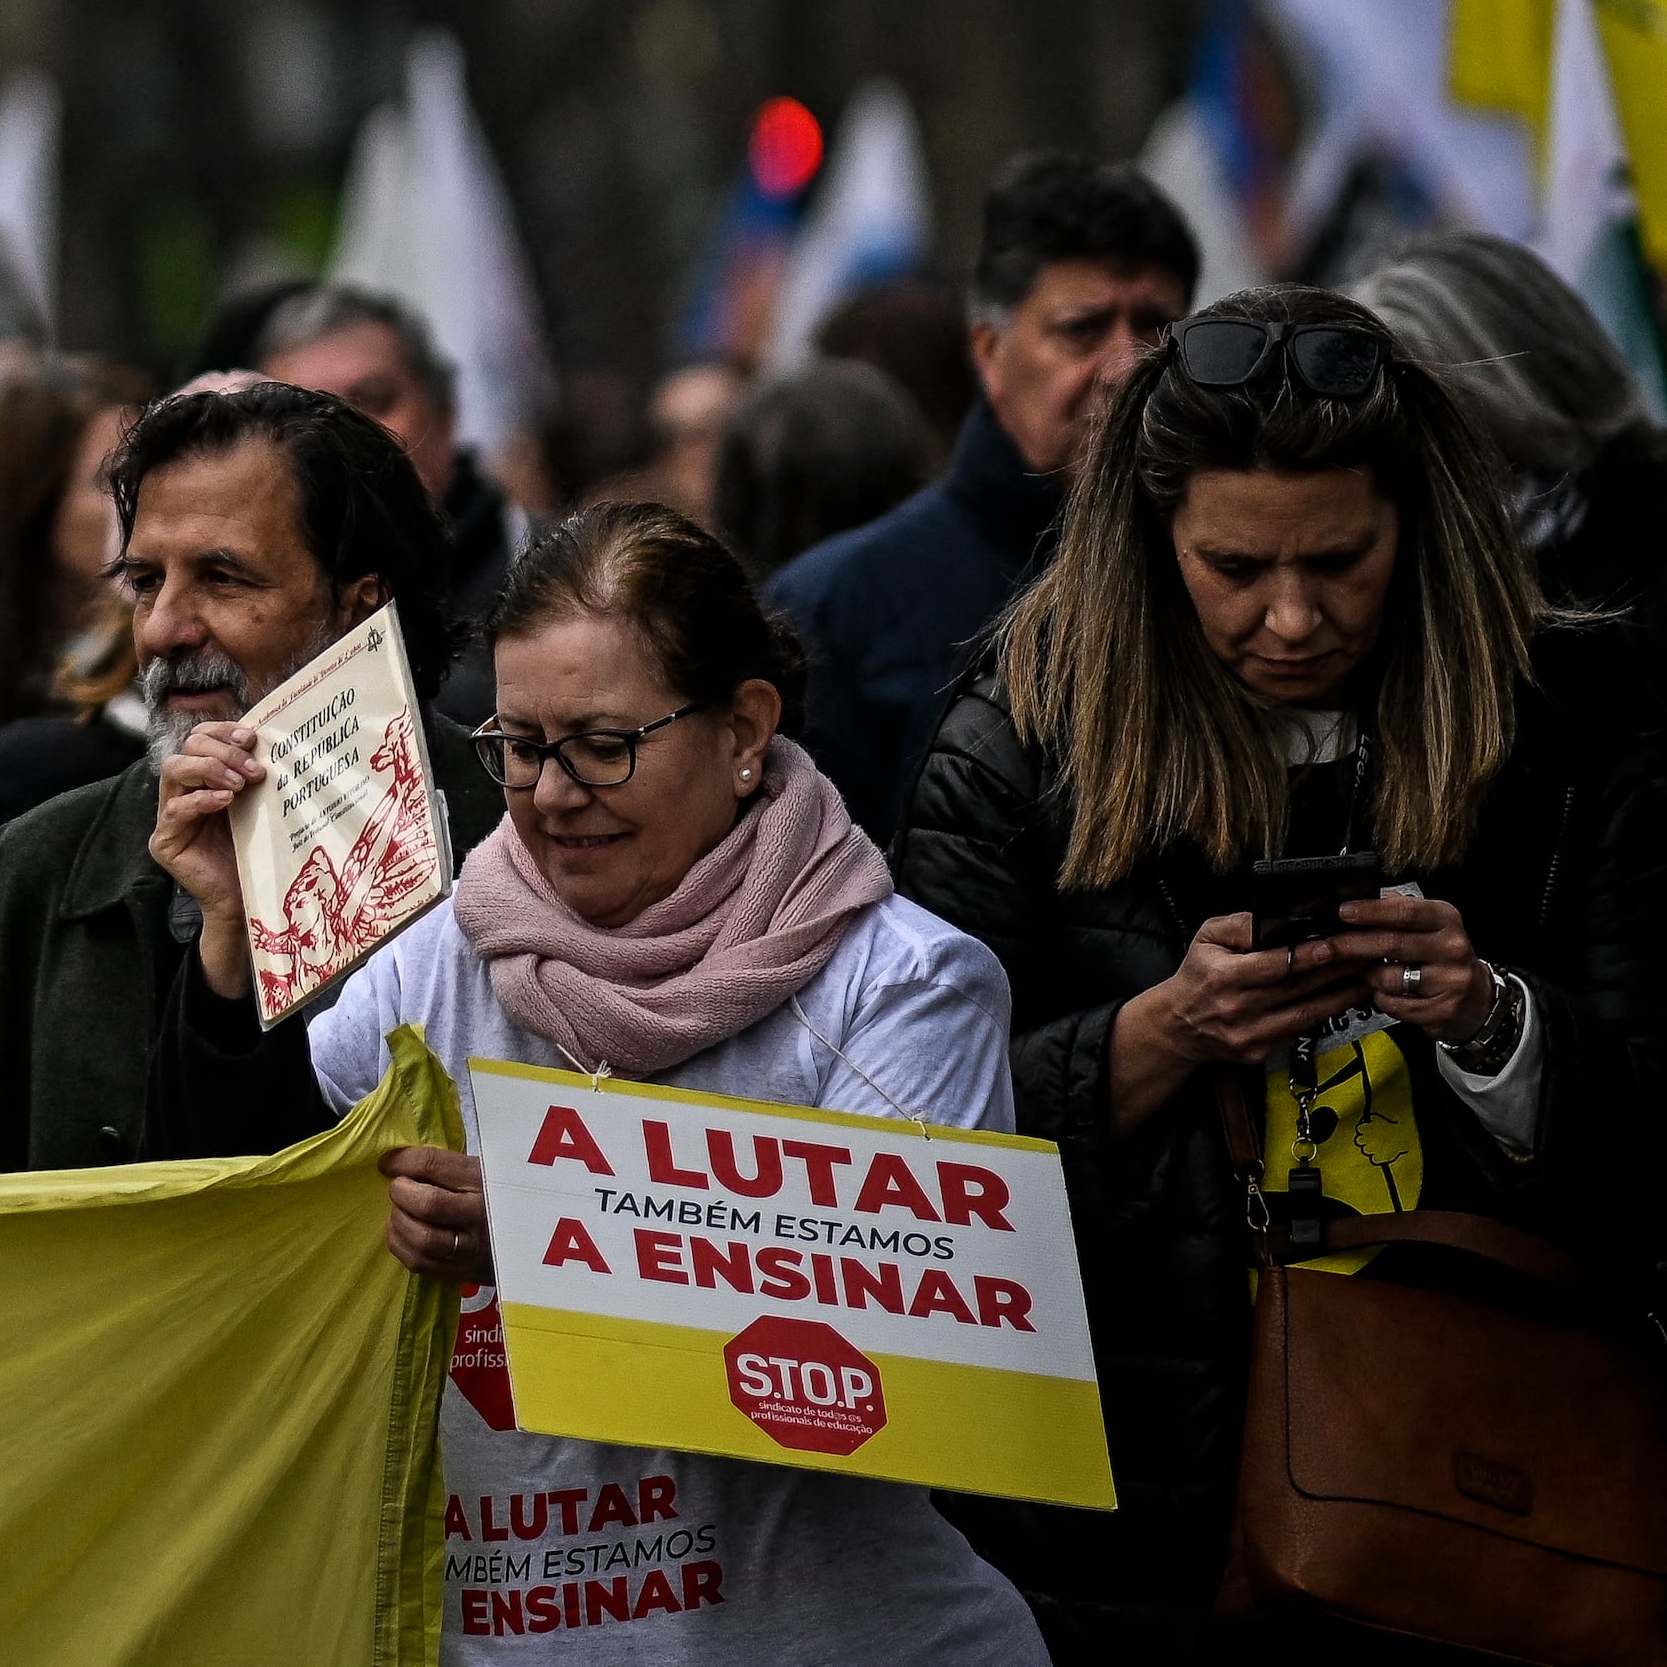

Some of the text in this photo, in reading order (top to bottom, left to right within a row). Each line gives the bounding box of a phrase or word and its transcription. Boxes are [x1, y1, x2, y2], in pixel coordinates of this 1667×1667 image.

[276, 714, 361, 792] da REPÚBLICA
[282, 746, 361, 818] PORTUGUESA
[526, 1104, 1017, 1233] A LUTAR
[593, 1187, 956, 1260] TAMBÉM ESTAMOS
[541, 1216, 1039, 1334] A ENSINAR
[464, 1323, 504, 1344] sindi
[750, 1410, 873, 1435] profissionais de educação
[758, 1400, 803, 1415] sindicato
[803, 1407, 816, 1417] de
[443, 1474, 680, 1542] A LUTAR
[445, 1524, 716, 1583] MBÉM ESTAMOS
[460, 1559, 726, 1636] ENSINAR
